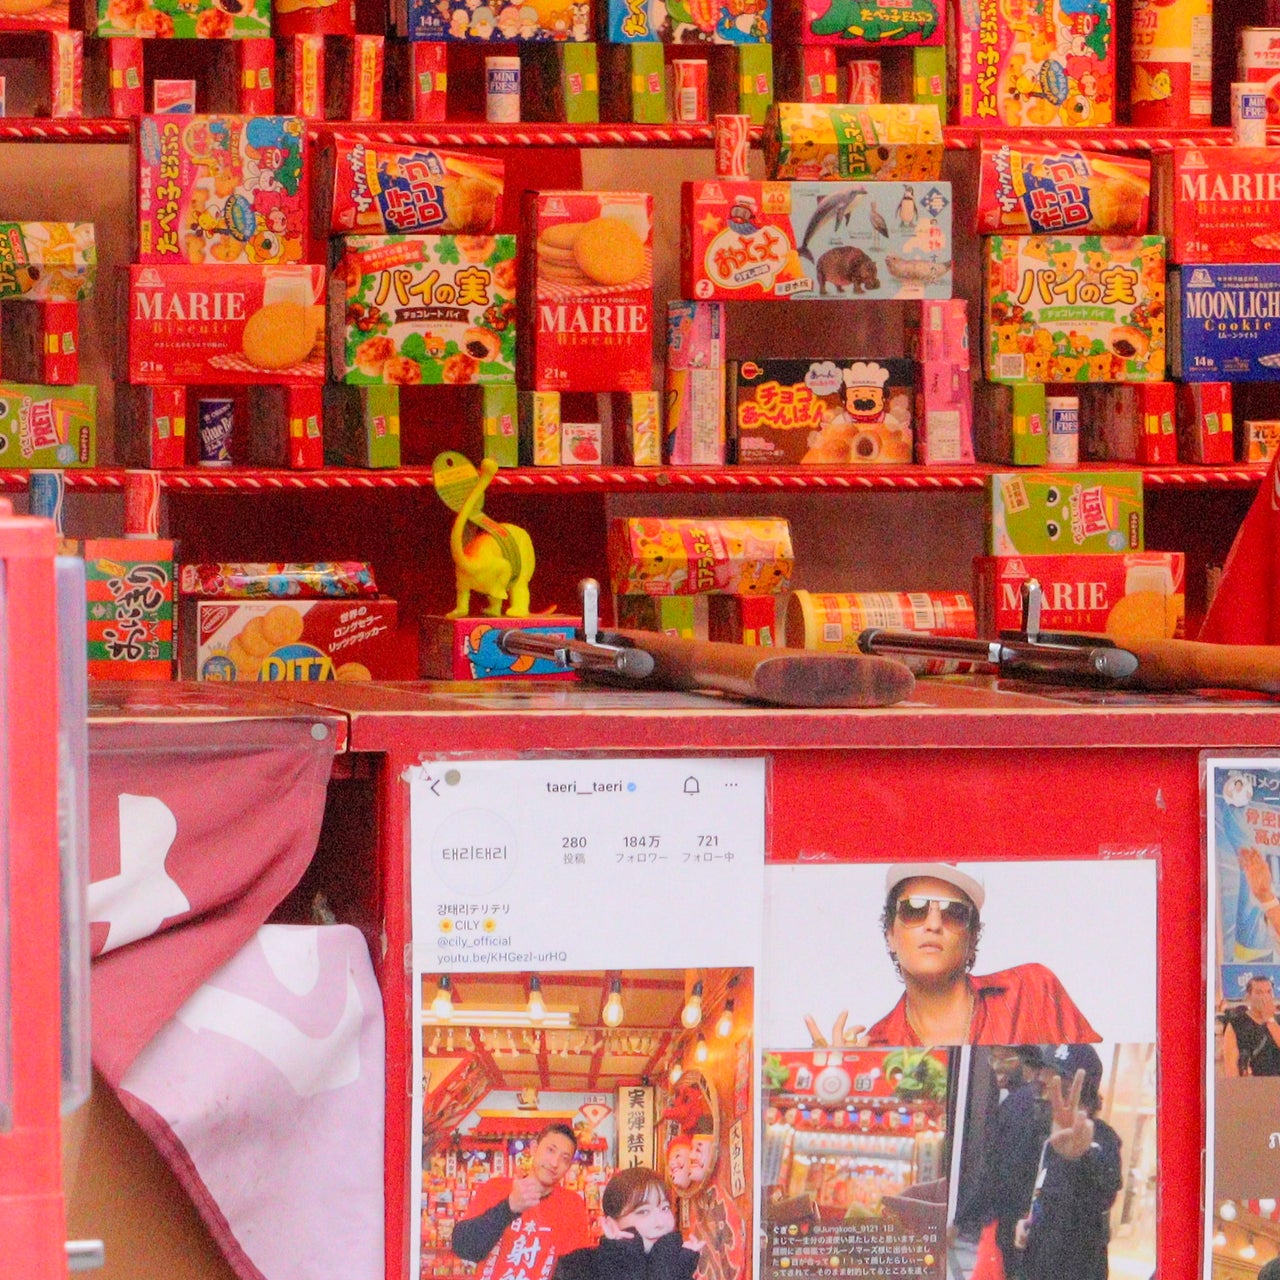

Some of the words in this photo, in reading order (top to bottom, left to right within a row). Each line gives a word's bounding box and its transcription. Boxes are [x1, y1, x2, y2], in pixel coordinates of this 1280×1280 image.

[157, 123, 181, 254] たべっ子どうぶつ
[405, 162, 442, 223] ロング
[1051, 162, 1089, 224] ロング
[387, 187, 415, 228] ポテ
[1032, 187, 1061, 229] ポテ
[714, 232, 780, 279] おっとっと
[374, 266, 491, 306] パイの実
[1017, 268, 1137, 305] パイの実
[135, 292, 245, 320] MARIE
[540, 306, 648, 333] MARIE
[1204, 319, 1271, 331] Cookie
[757, 384, 812, 405] チョコ
[1081, 487, 1110, 538] PRETZ
[103, 564, 167, 662] おにぎり
[341, 606, 367, 623] 世界の
[334, 615, 383, 638] ロングセラー
[547, 780, 623, 795] taeri__taeri
[562, 837, 587, 848] 280
[624, 836, 660, 848] 184万
[698, 836, 719, 847] 721
[442, 847, 507, 860] 태리태리
[564, 853, 586, 864] 投稿
[616, 853, 667, 863] フォロワー
[684, 852, 735, 862] フォロー中
[455, 920, 480, 931] CILY
[437, 936, 511, 948] @cily_official
[627, 1088, 645, 1169] 実弾禁止
[510, 1220, 551, 1233] 日本一
